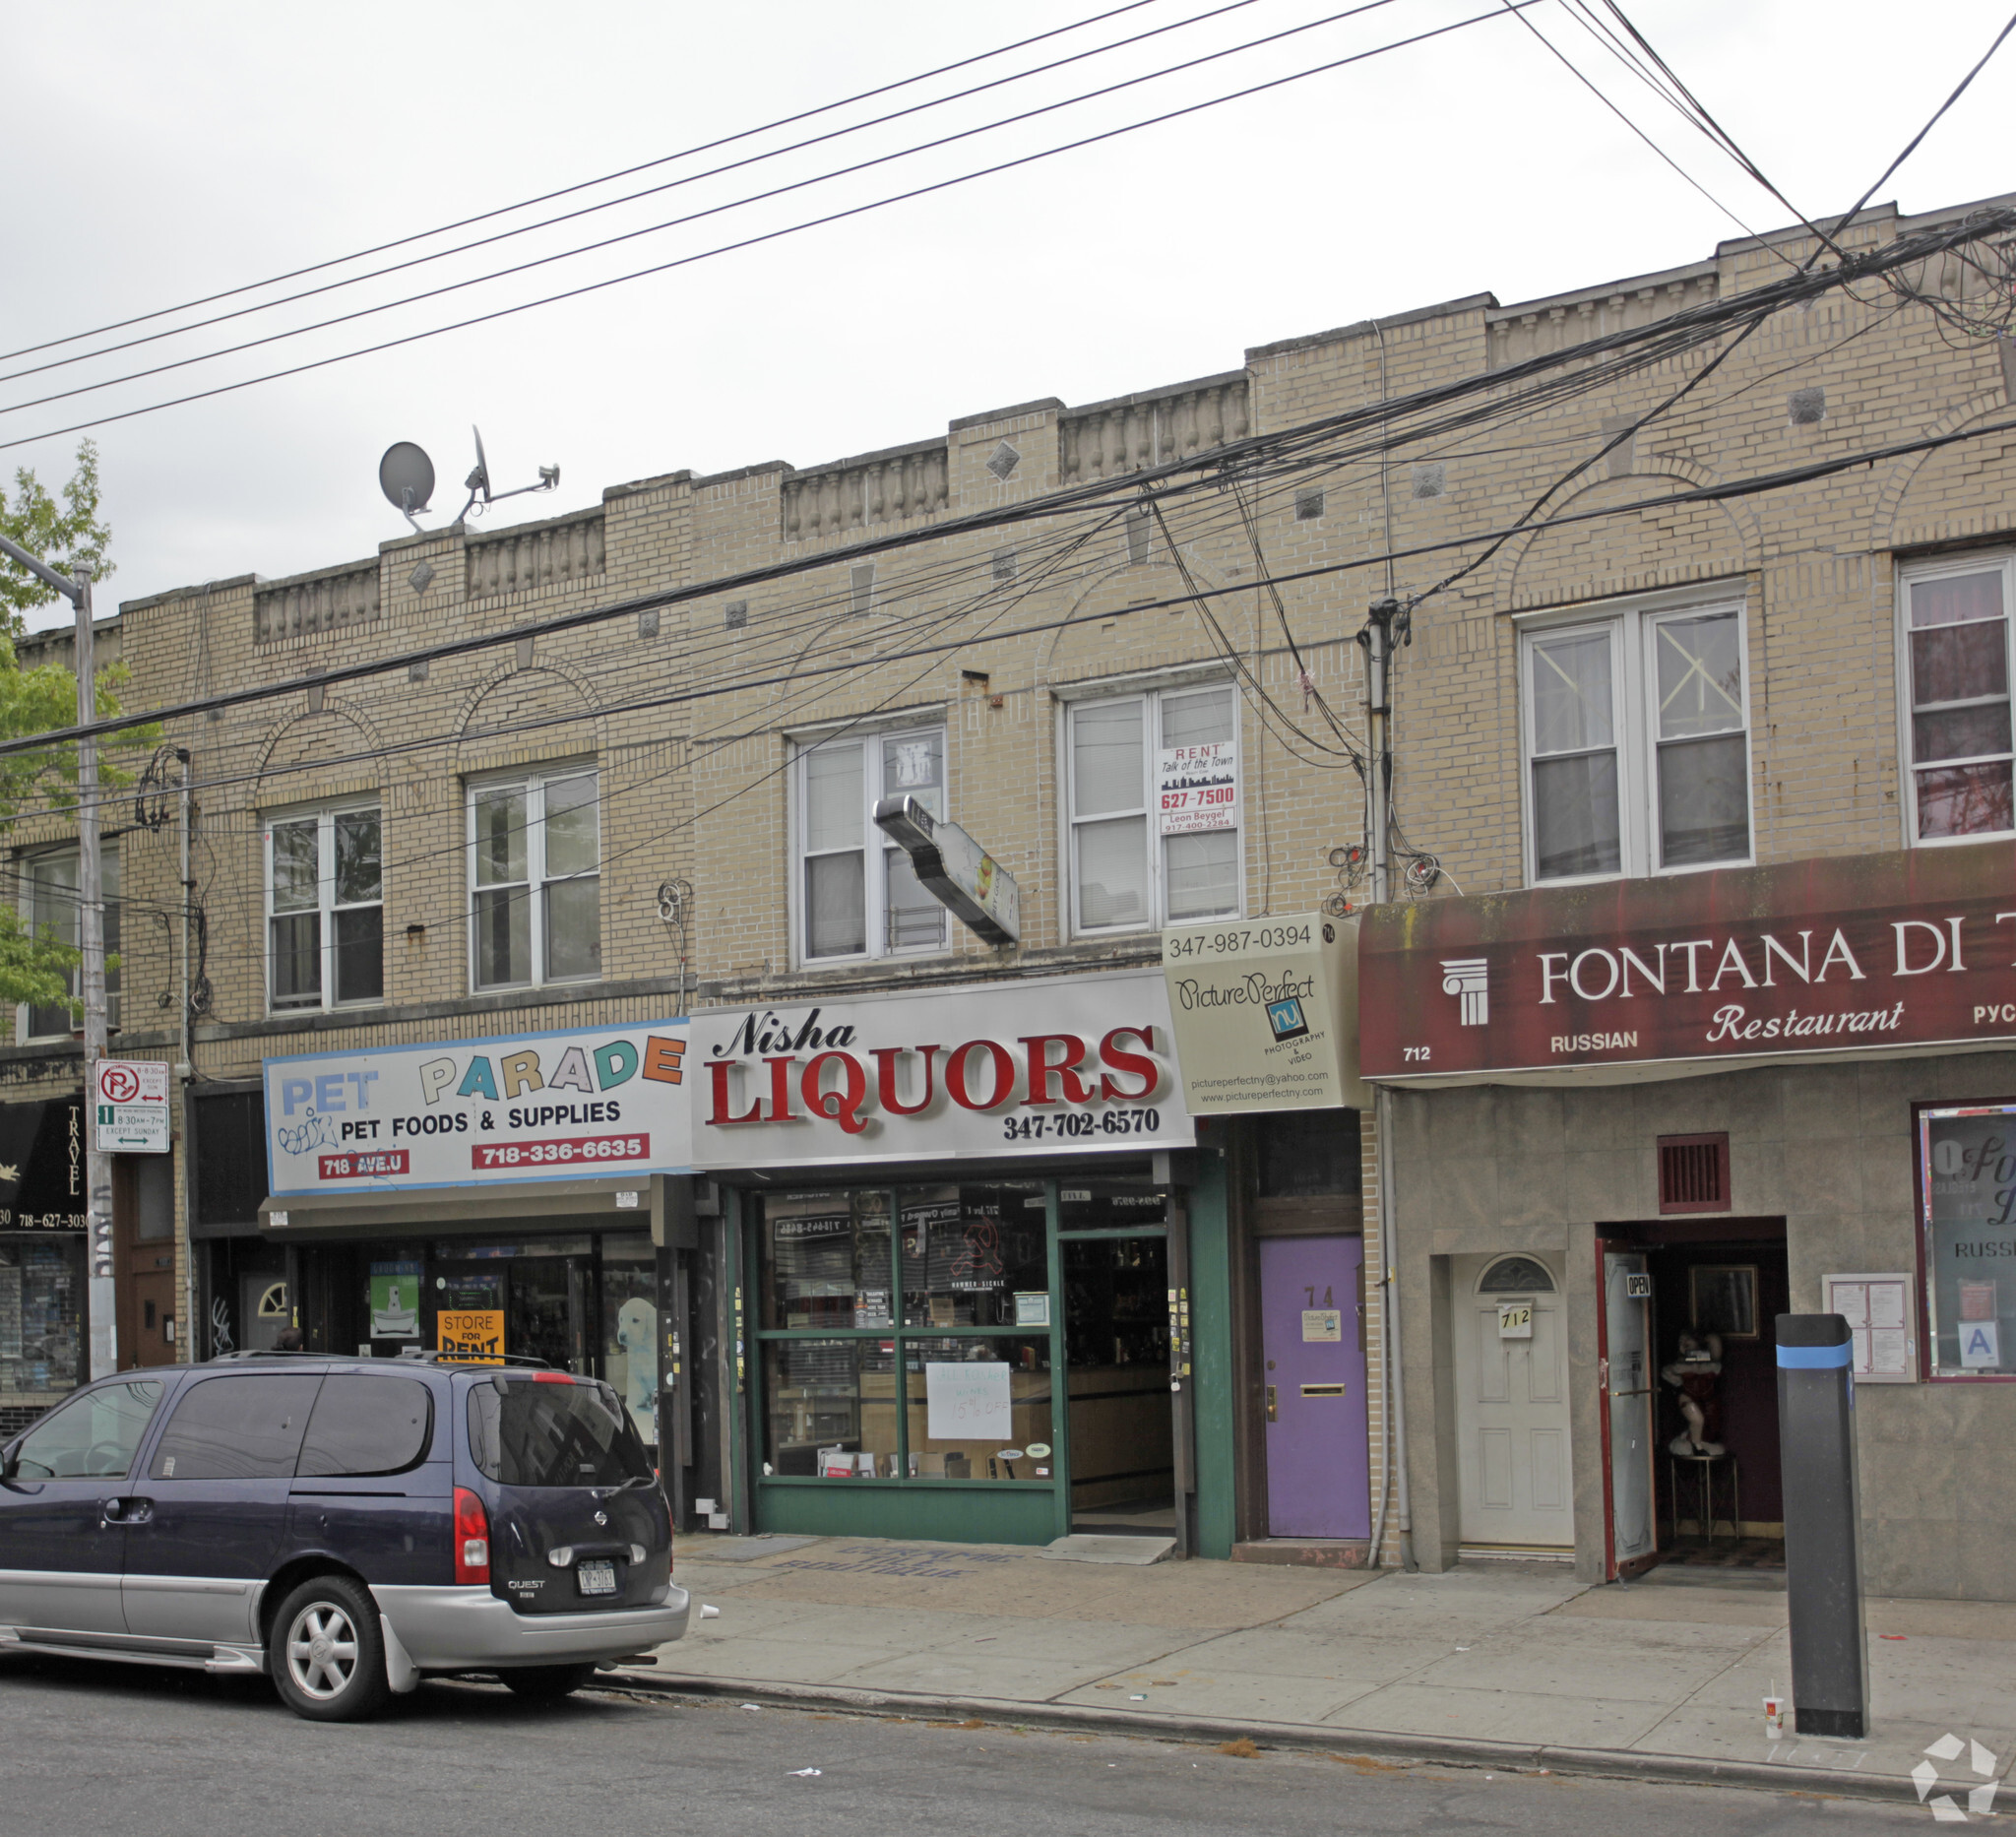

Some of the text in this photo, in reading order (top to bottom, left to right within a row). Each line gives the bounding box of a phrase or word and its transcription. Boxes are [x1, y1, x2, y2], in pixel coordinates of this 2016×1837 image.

[1175, 744, 1221, 760] RENT
[1162, 756, 1233, 773] Talk of the Town
[1162, 788, 1234, 809] 627-7500
[1166, 819, 1229, 831] 917-400-2284
[1170, 809, 1225, 823] Leon Beygel
[1169, 924, 1311, 958] 347-987-0394
[1537, 927, 1866, 1004] FONTANA
[1891, 917, 1968, 977] DI
[1175, 970, 1314, 1010] Picture Perfect
[712, 1007, 857, 1058] Nisha
[1706, 1001, 1905, 1043] Restaurant
[1264, 1031, 1326, 1055] PHOTOGRAPHY
[1550, 1031, 1638, 1053] RUSSIAN
[1288, 1052, 1312, 1065] VIDEO
[1403, 1045, 1430, 1062] 712
[418, 1035, 687, 1107] PARADE
[703, 1025, 1160, 1134] LIQUORS
[1191, 1070, 1329, 1091] pictureperfectny@yahoo.com
[282, 1071, 379, 1116] PET
[1201, 1087, 1323, 1104] www.pictureperfectny.com
[341, 1119, 381, 1141] PET
[392, 1111, 468, 1137] FOODS
[480, 1109, 495, 1130] &
[508, 1101, 621, 1128] SUPPLIES
[1003, 1108, 1161, 1140] 347-702-6570
[68, 1106, 80, 1196] TRAVEL
[482, 1139, 642, 1166] 718-336-6635
[324, 1159, 350, 1175] 718
[1628, 1276, 1649, 1295] OPEN
[444, 1315, 494, 1330] STORE
[1502, 1309, 1529, 1329] 712
[462, 1332, 480, 1341] FOR
[1968, 1329, 1991, 1356] A
[442, 1336, 499, 1361] RENT
[508, 1580, 545, 1590] QUEST
